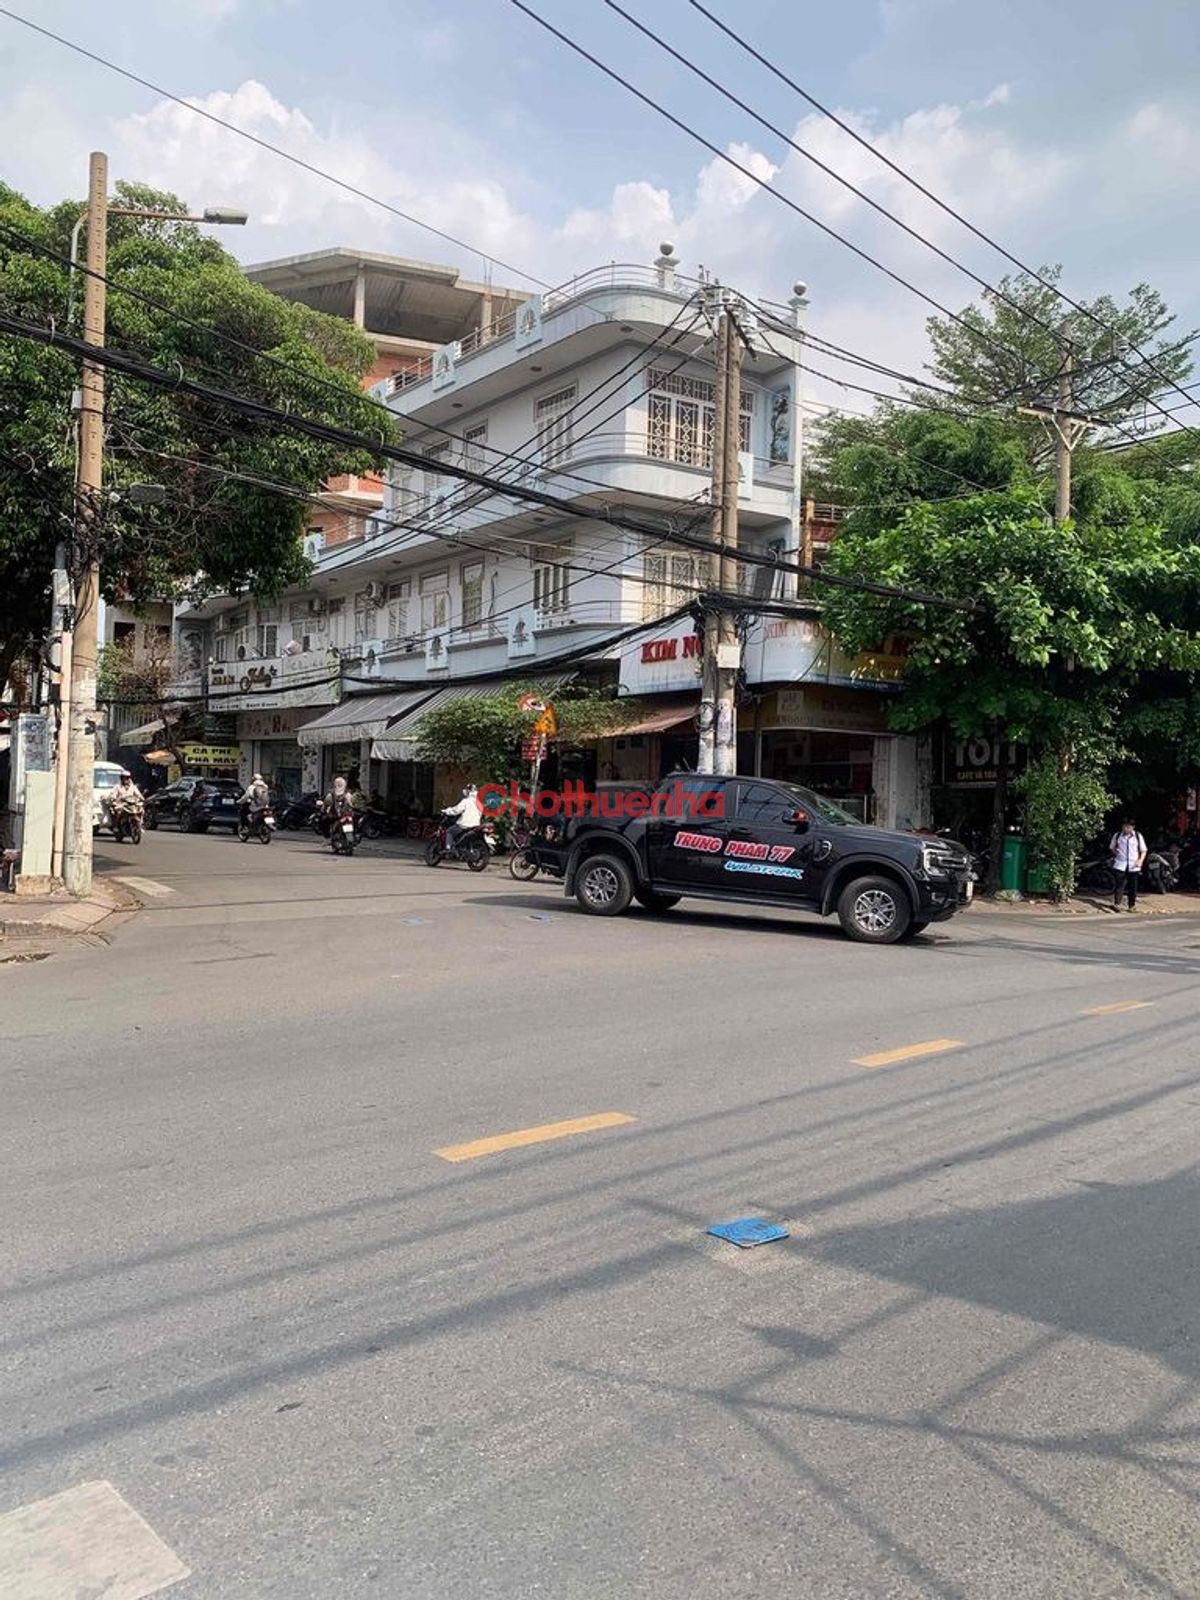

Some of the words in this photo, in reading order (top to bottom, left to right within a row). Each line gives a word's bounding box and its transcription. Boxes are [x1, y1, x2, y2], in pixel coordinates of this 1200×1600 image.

[641, 638, 677, 663] KIM
[674, 831, 722, 852] TRUNG
[768, 845, 795, 862] 77
